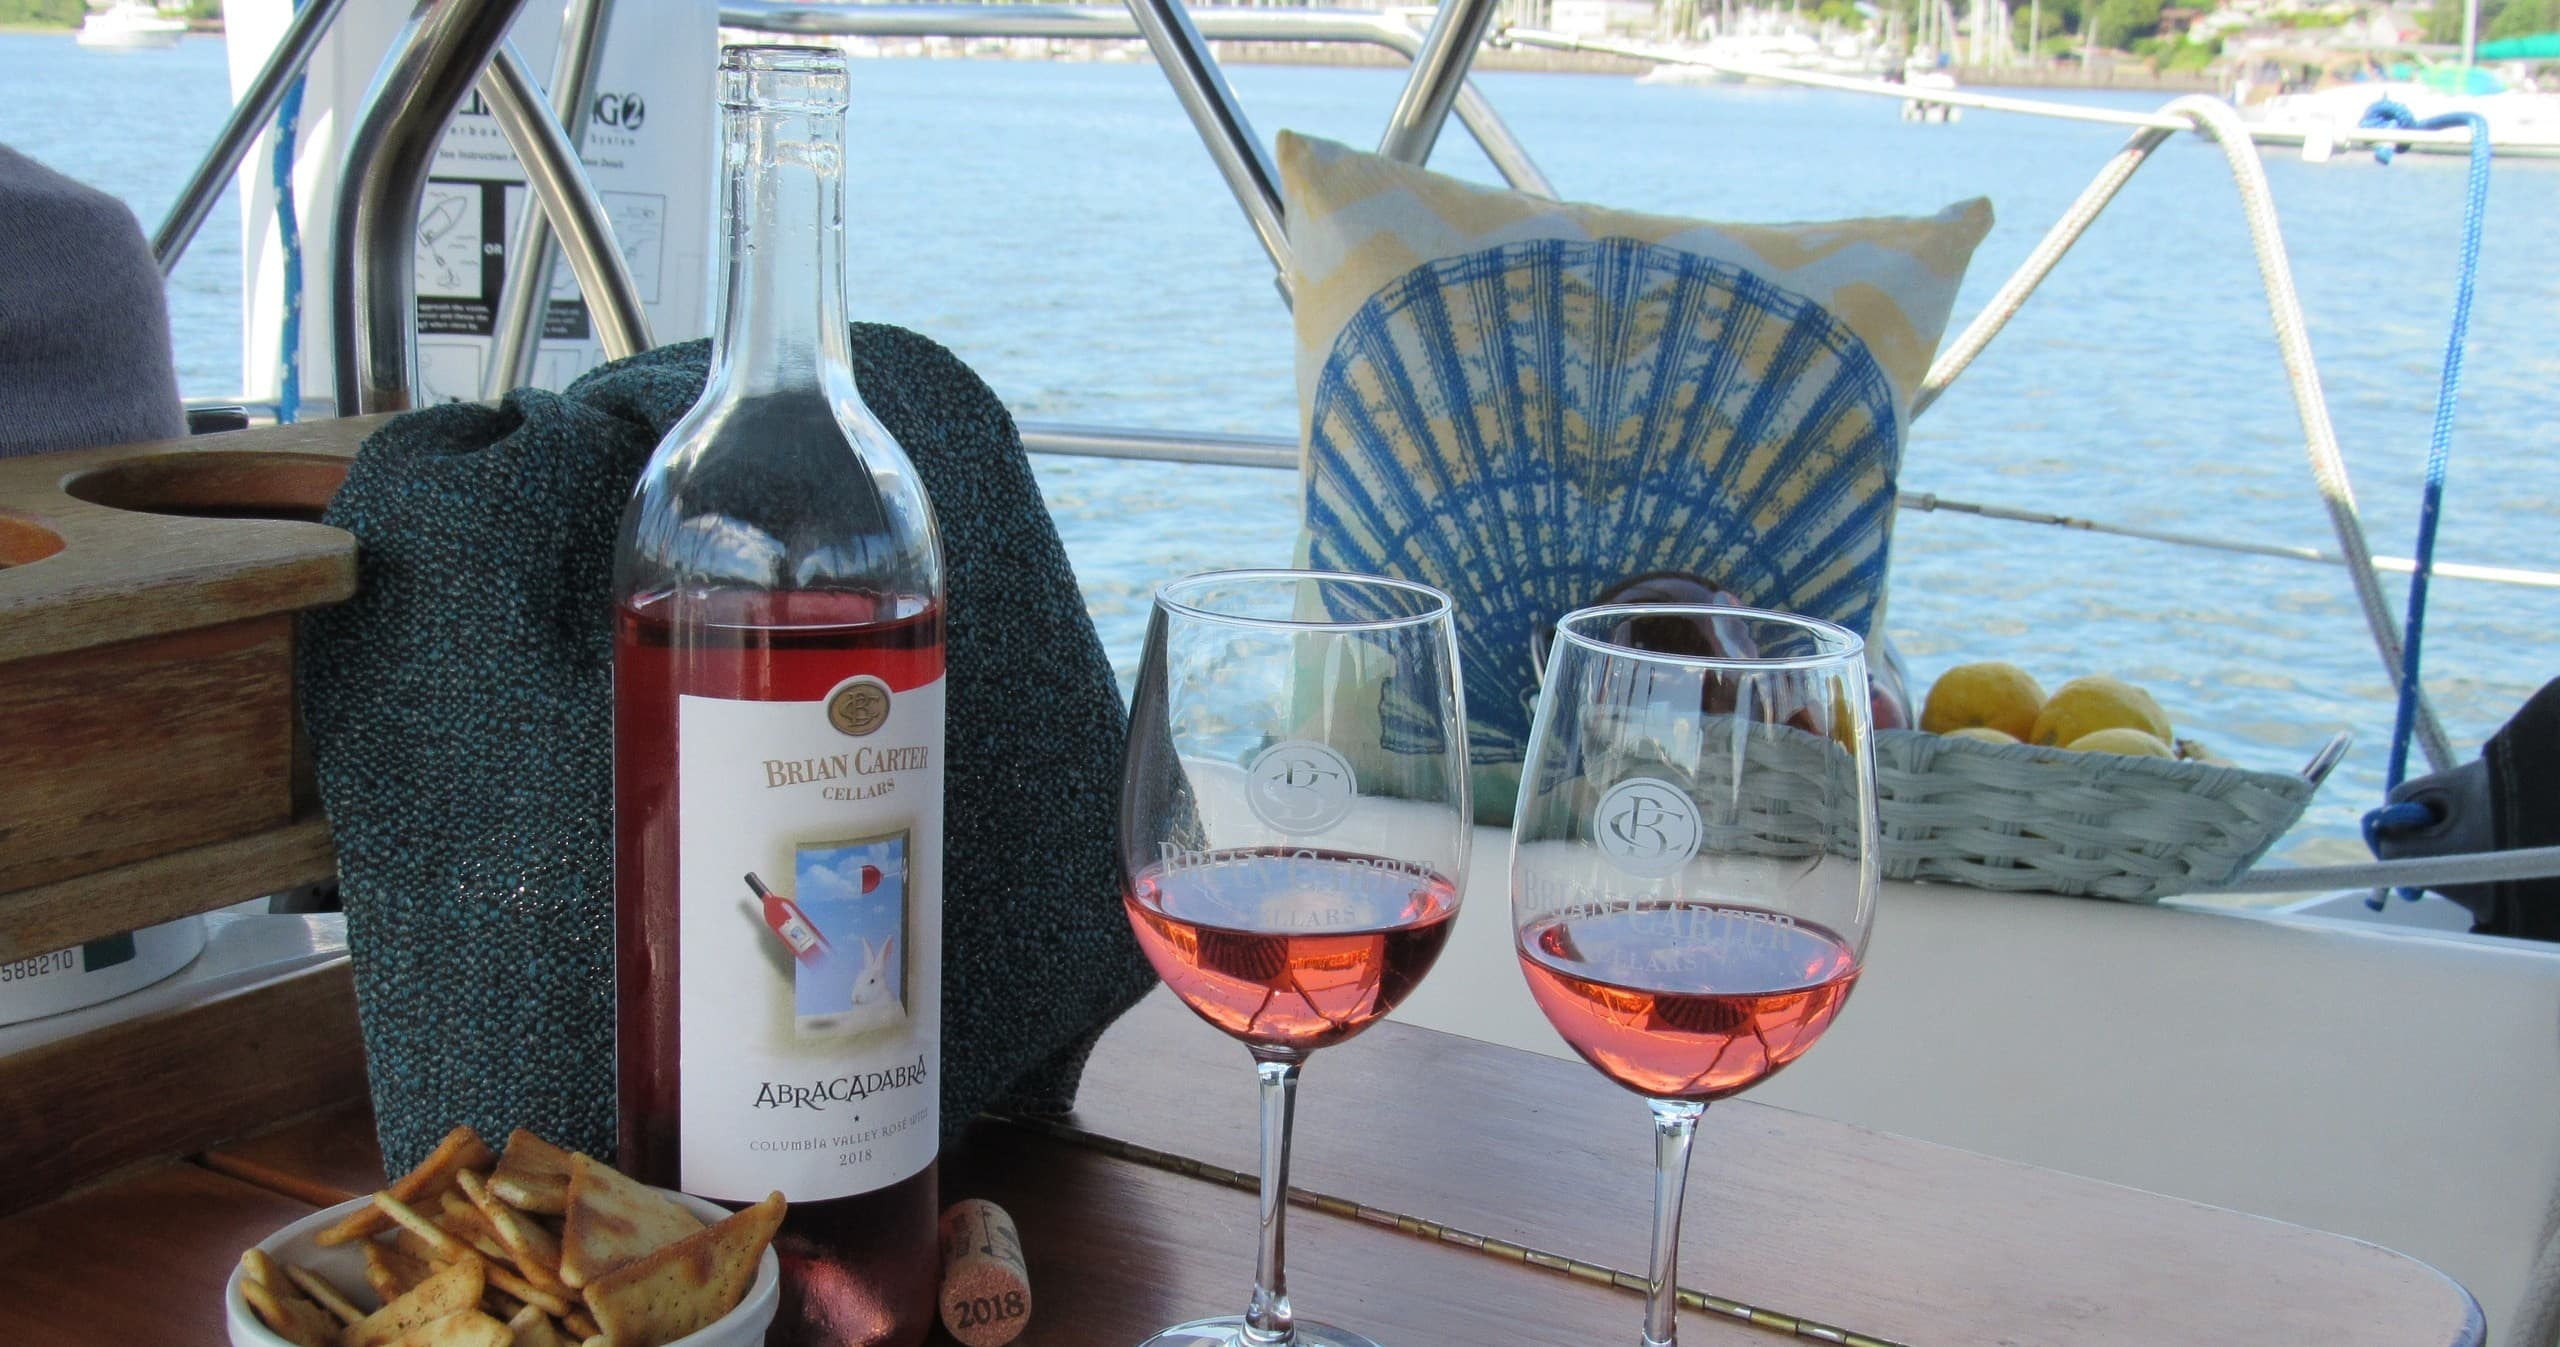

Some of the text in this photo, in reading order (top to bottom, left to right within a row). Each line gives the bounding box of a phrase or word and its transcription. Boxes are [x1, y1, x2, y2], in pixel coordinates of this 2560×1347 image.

[484, 243, 503, 255] OR
[763, 746, 928, 788] BRIAN CARTER
[822, 778, 896, 801] CELLARS
[1, 949, 74, 983] 588210
[752, 1053, 928, 1111] ABRACADABRA
[833, 1128, 879, 1147] VALLEY
[882, 1117, 908, 1137] ROSÉ
[839, 1149, 872, 1167] 2018
[954, 1290, 1025, 1329] 2018
